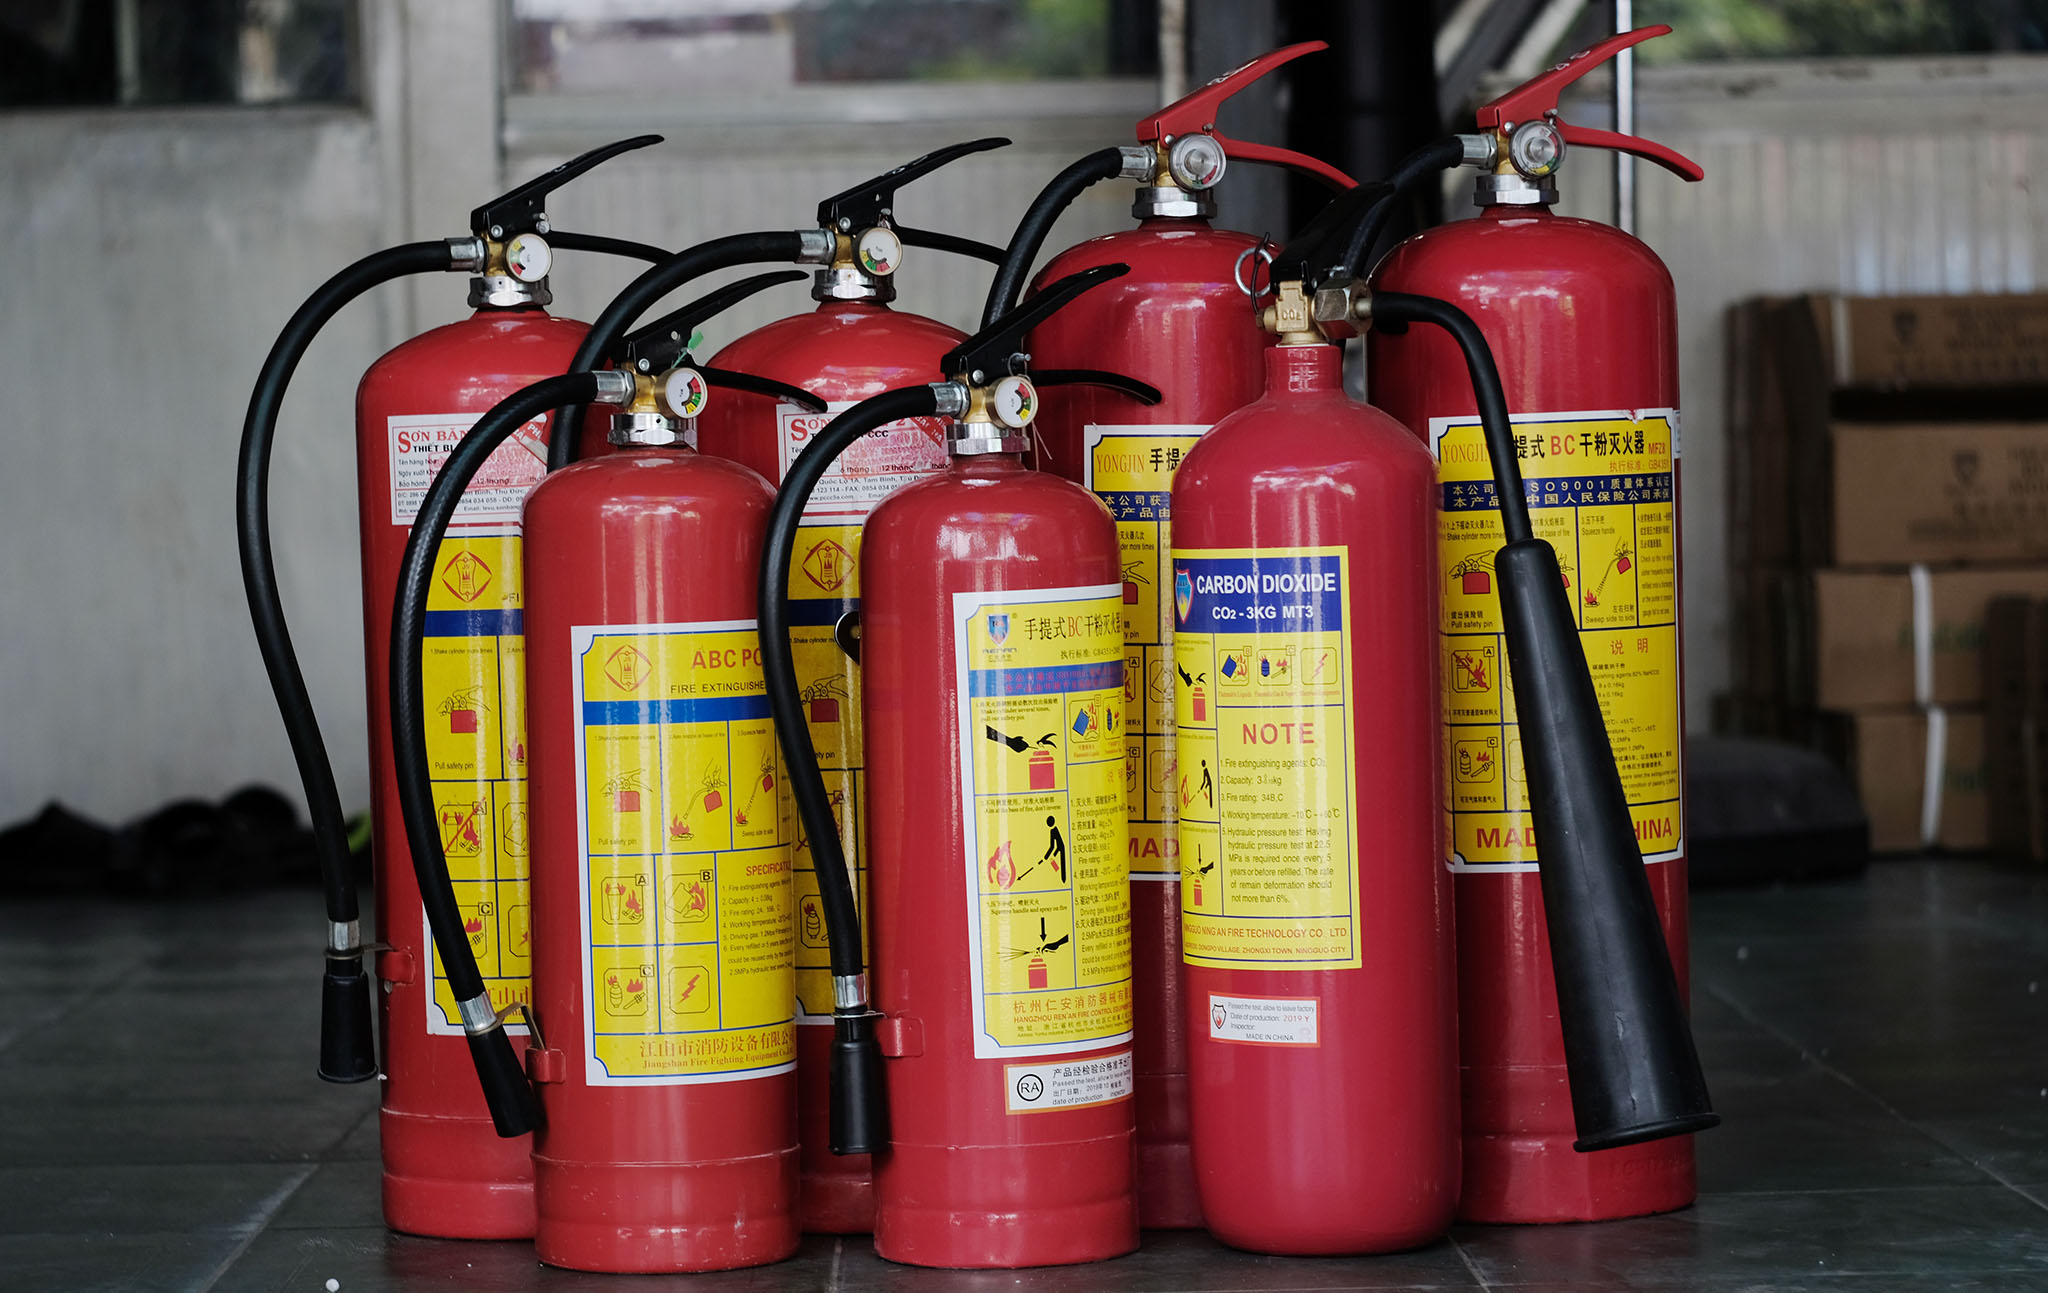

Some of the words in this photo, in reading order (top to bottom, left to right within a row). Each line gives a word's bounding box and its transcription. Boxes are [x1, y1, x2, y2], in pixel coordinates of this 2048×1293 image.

[398, 428, 431, 454] SƠN
[1551, 434, 1576, 456] BC
[1579, 430, 1645, 457] 干粉灭火器
[1096, 454, 1145, 473] YONGJIN
[1149, 448, 1184, 473] 手提
[1196, 575, 1258, 594] CARBON
[1262, 572, 1336, 594] DIOXIDE
[1246, 606, 1277, 619] 3KG
[1282, 605, 1314, 619] MT3
[1485, 648, 1492, 656] A
[691, 649, 737, 669] ABC
[670, 684, 697, 694] FIRE
[702, 680, 767, 693] EXTINGUISHE
[1242, 722, 1315, 745] NOTE
[1489, 738, 1496, 746] C
[445, 761, 463, 772] safety
[463, 762, 474, 772] pin
[1238, 758, 1281, 770] extinguishing
[1256, 829, 1287, 839] pressure
[1476, 827, 1537, 849] MAD
[1128, 838, 1180, 858] MAD
[1228, 840, 1257, 851] hydraulic
[1258, 841, 1288, 852] pressure
[1305, 841, 1313, 849] at
[1228, 853, 1243, 863] MPa
[1252, 854, 1281, 865] required
[1282, 854, 1301, 863] once
[1303, 854, 1323, 866] every
[702, 870, 711, 881] B
[1230, 867, 1246, 878] years
[1247, 868, 1254, 877] or
[1254, 867, 1276, 877] before
[637, 875, 647, 886] A
[1230, 880, 1237, 889] of
[1239, 880, 1261, 889] remain
[1263, 880, 1305, 890] deformation
[1307, 879, 1332, 889] should
[1231, 894, 1241, 903] not
[1241, 895, 1259, 903] more
[1259, 893, 1275, 903] than
[480, 904, 491, 915] C
[1227, 928, 1245, 938] FIRE
[1246, 928, 1306, 939] TECHNOLOGY
[1330, 946, 1346, 954] CITY
[1013, 1014, 1053, 1024] HANGZHOU
[1077, 1010, 1090, 1019] FIRE
[1245, 1033, 1264, 1041] MADE
[1265, 1033, 1272, 1041] IN
[1272, 1033, 1294, 1041] CHINA
[642, 1058, 689, 1069] Jiangshan
[690, 1056, 708, 1067] Fire
[710, 1054, 744, 1066] Fighting
[744, 1049, 779, 1064] Equipment
[1020, 1081, 1041, 1095] RA
[1052, 1078, 1075, 1089] Passed
[1052, 1097, 1067, 1106] date
[1067, 1096, 1074, 1105] of
[1074, 1092, 1104, 1105] production
